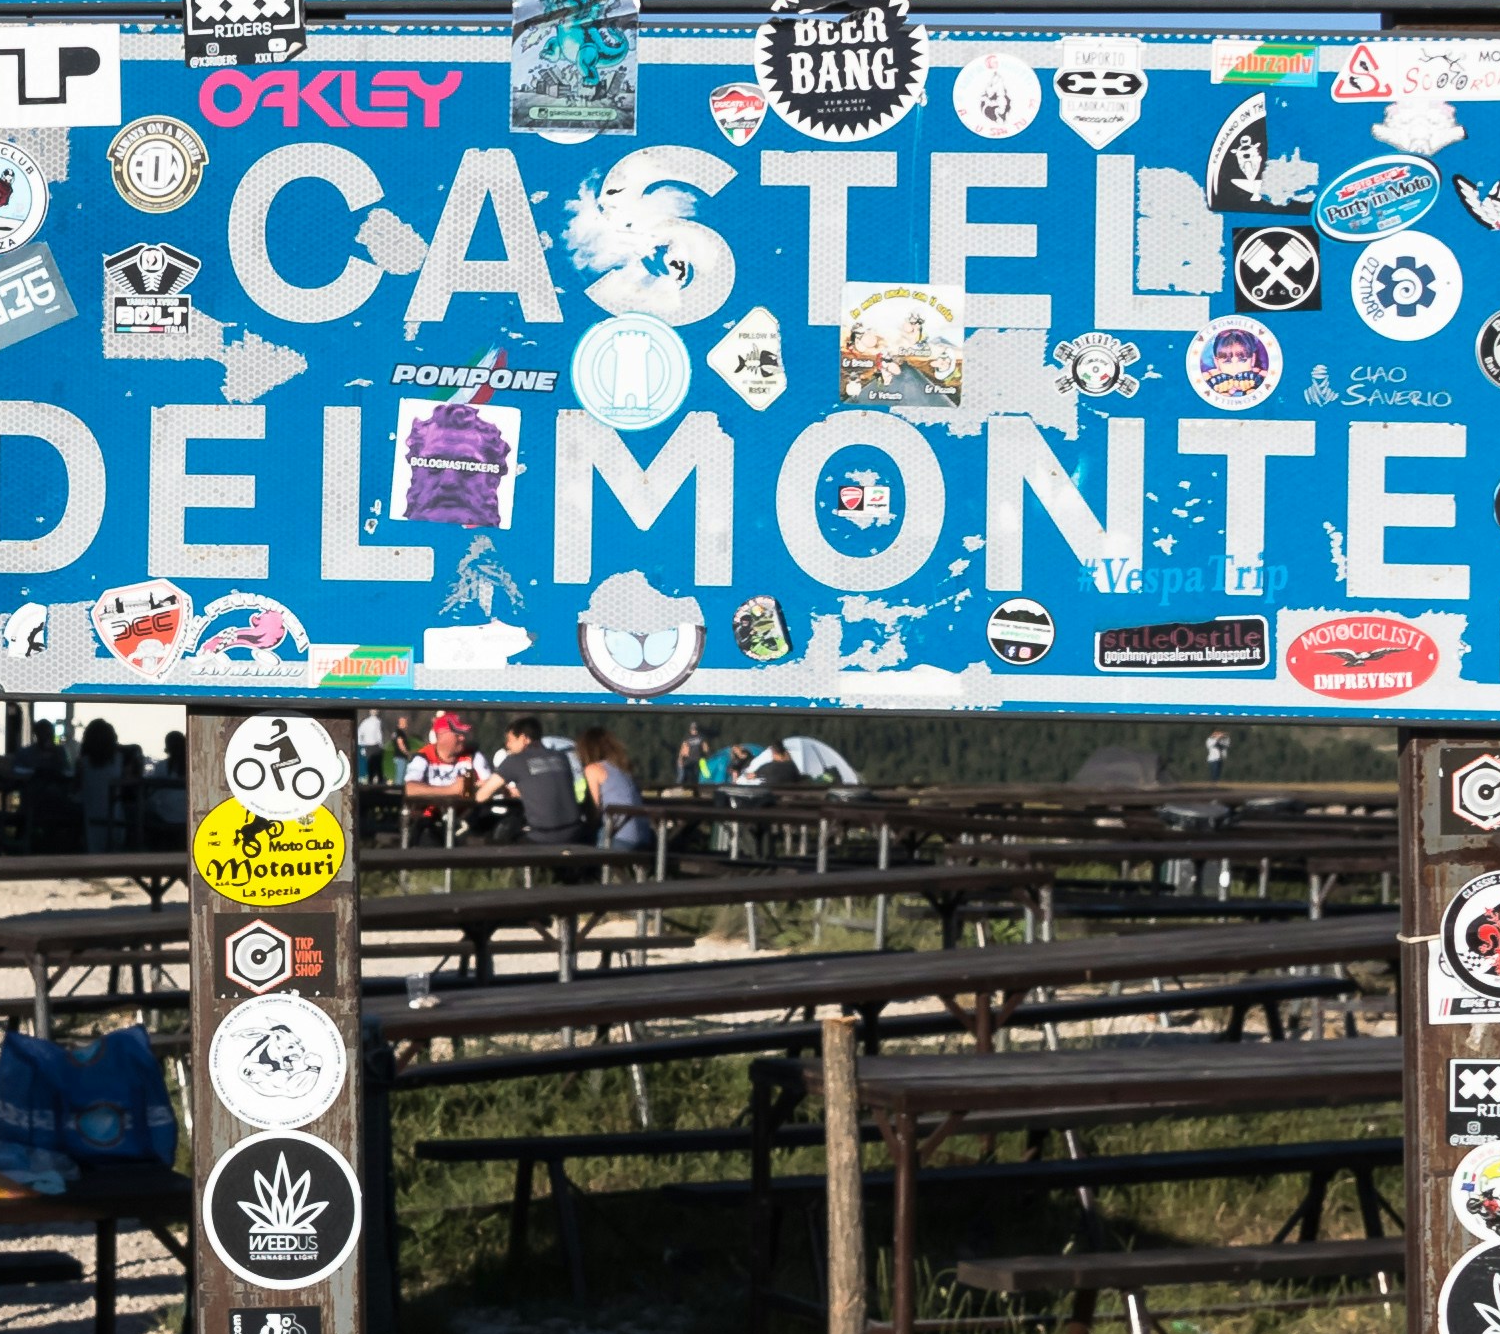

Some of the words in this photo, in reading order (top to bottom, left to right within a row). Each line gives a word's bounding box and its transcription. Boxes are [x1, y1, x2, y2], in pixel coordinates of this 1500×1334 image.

[214, 22, 272, 38] RIDERS
[794, 5, 889, 48] BEER
[1075, 50, 1126, 67] EMPORIO
[1219, 52, 1313, 75] #abrzadv
[789, 47, 899, 96] BANG
[199, 69, 463, 128] OAKLEY
[824, 98, 866, 107] TERAMO
[1067, 99, 1131, 113] ELABORAZIONI
[817, 105, 872, 114] MACERATA
[114, 126, 147, 160] ALWAYS
[147, 123, 163, 135] ON
[165, 124, 173, 136] A
[175, 128, 202, 161] WHEEL
[1326, 194, 1373, 223] Party
[1390, 175, 1432, 199] Moto
[227, 142, 1210, 333] CASTEL
[861, 294, 883, 311] moto
[885, 287, 911, 299] anche
[913, 291, 928, 302] con
[115, 306, 188, 326] BOLT
[165, 325, 186, 334] ITALIA
[738, 332, 767, 340] FOLLOW
[1349, 366, 1407, 383] CIAO
[1484, 356, 1499, 378] Bari
[392, 364, 559, 392] POMPONE
[1340, 384, 1452, 407] SAVERIO
[410, 456, 500, 475] BOLOGNASTICKERS
[552, 408, 1471, 601] MONTE
[1077, 553, 1288, 606] #VespaTrip
[1104, 623, 1262, 649] stileOstile
[1300, 622, 1427, 651] MOTOCICLISTI
[1104, 647, 1261, 664] gojohnnygosalerno.blogspot.it
[316, 654, 409, 679] #abrzadv
[1313, 672, 1413, 690] IMPREVISTI
[269, 840, 303, 852] Moto
[305, 839, 335, 851] Club
[206, 854, 335, 887] Motauri
[243, 887, 257, 898] La
[261, 886, 300, 899] Spezia
[1462, 874, 1497, 901] CLASSIC
[295, 937, 314, 950] TKP
[295, 951, 324, 964] VINYL
[295, 964, 322, 977] SHOP
[249, 1235, 318, 1251] WEEDUS
